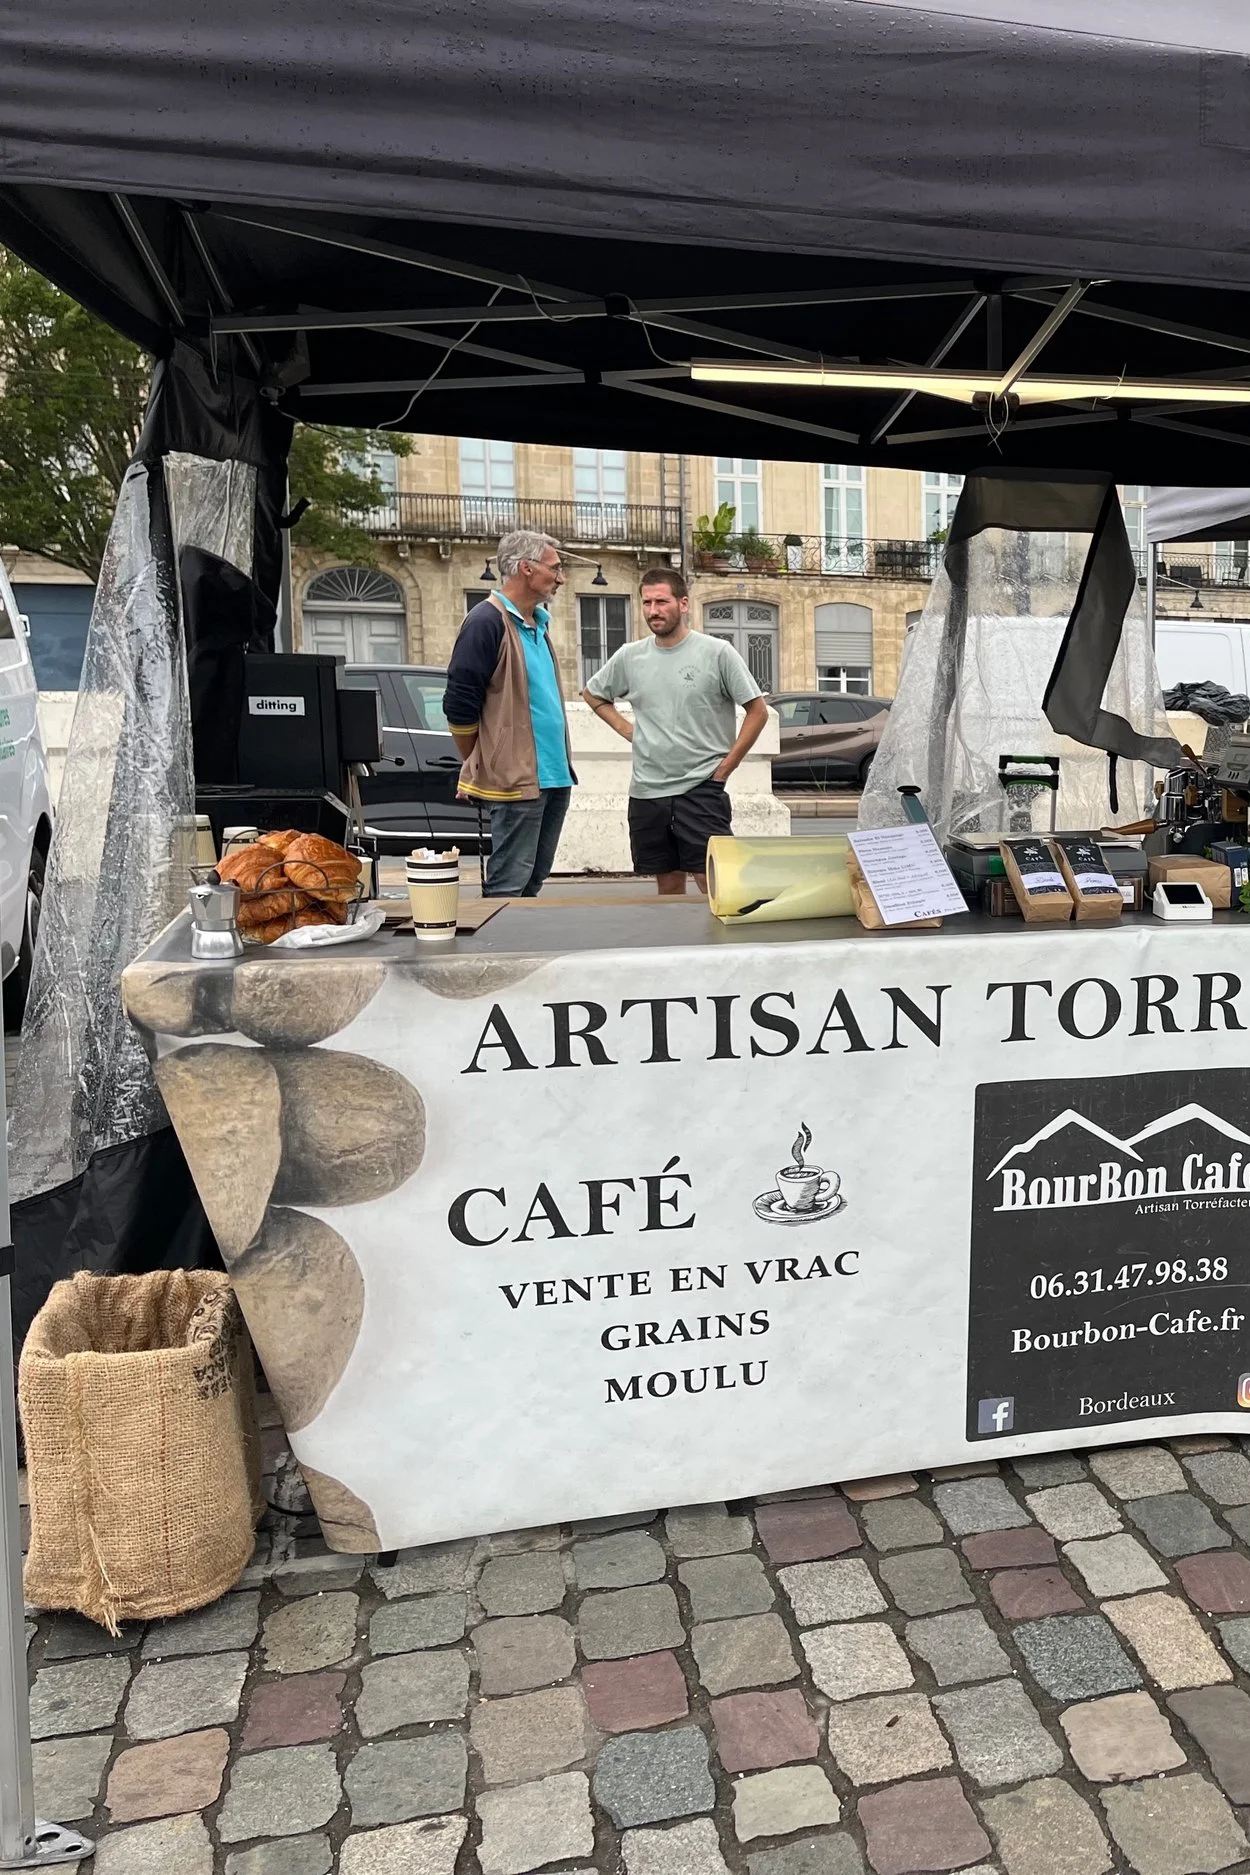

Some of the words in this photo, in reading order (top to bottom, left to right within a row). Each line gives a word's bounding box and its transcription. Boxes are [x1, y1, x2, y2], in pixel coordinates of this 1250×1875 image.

[256, 699, 297, 713] ditting
[461, 985, 951, 1074] ARTISAN
[448, 1156, 696, 1246] CAFÉ
[1135, 1202, 1179, 1215] Artisan
[499, 1271, 651, 1308] VENTE
[669, 1265, 727, 1292] EN
[744, 1251, 860, 1285] VRAC
[1031, 1257, 1228, 1299] 06.31.47.98.38
[601, 1310, 769, 1350] GRAINS
[1011, 1307, 1245, 1352] Bourbon-Cafe.fr
[605, 1361, 769, 1403] MOULU
[1079, 1392, 1175, 1415] Bordeaux
